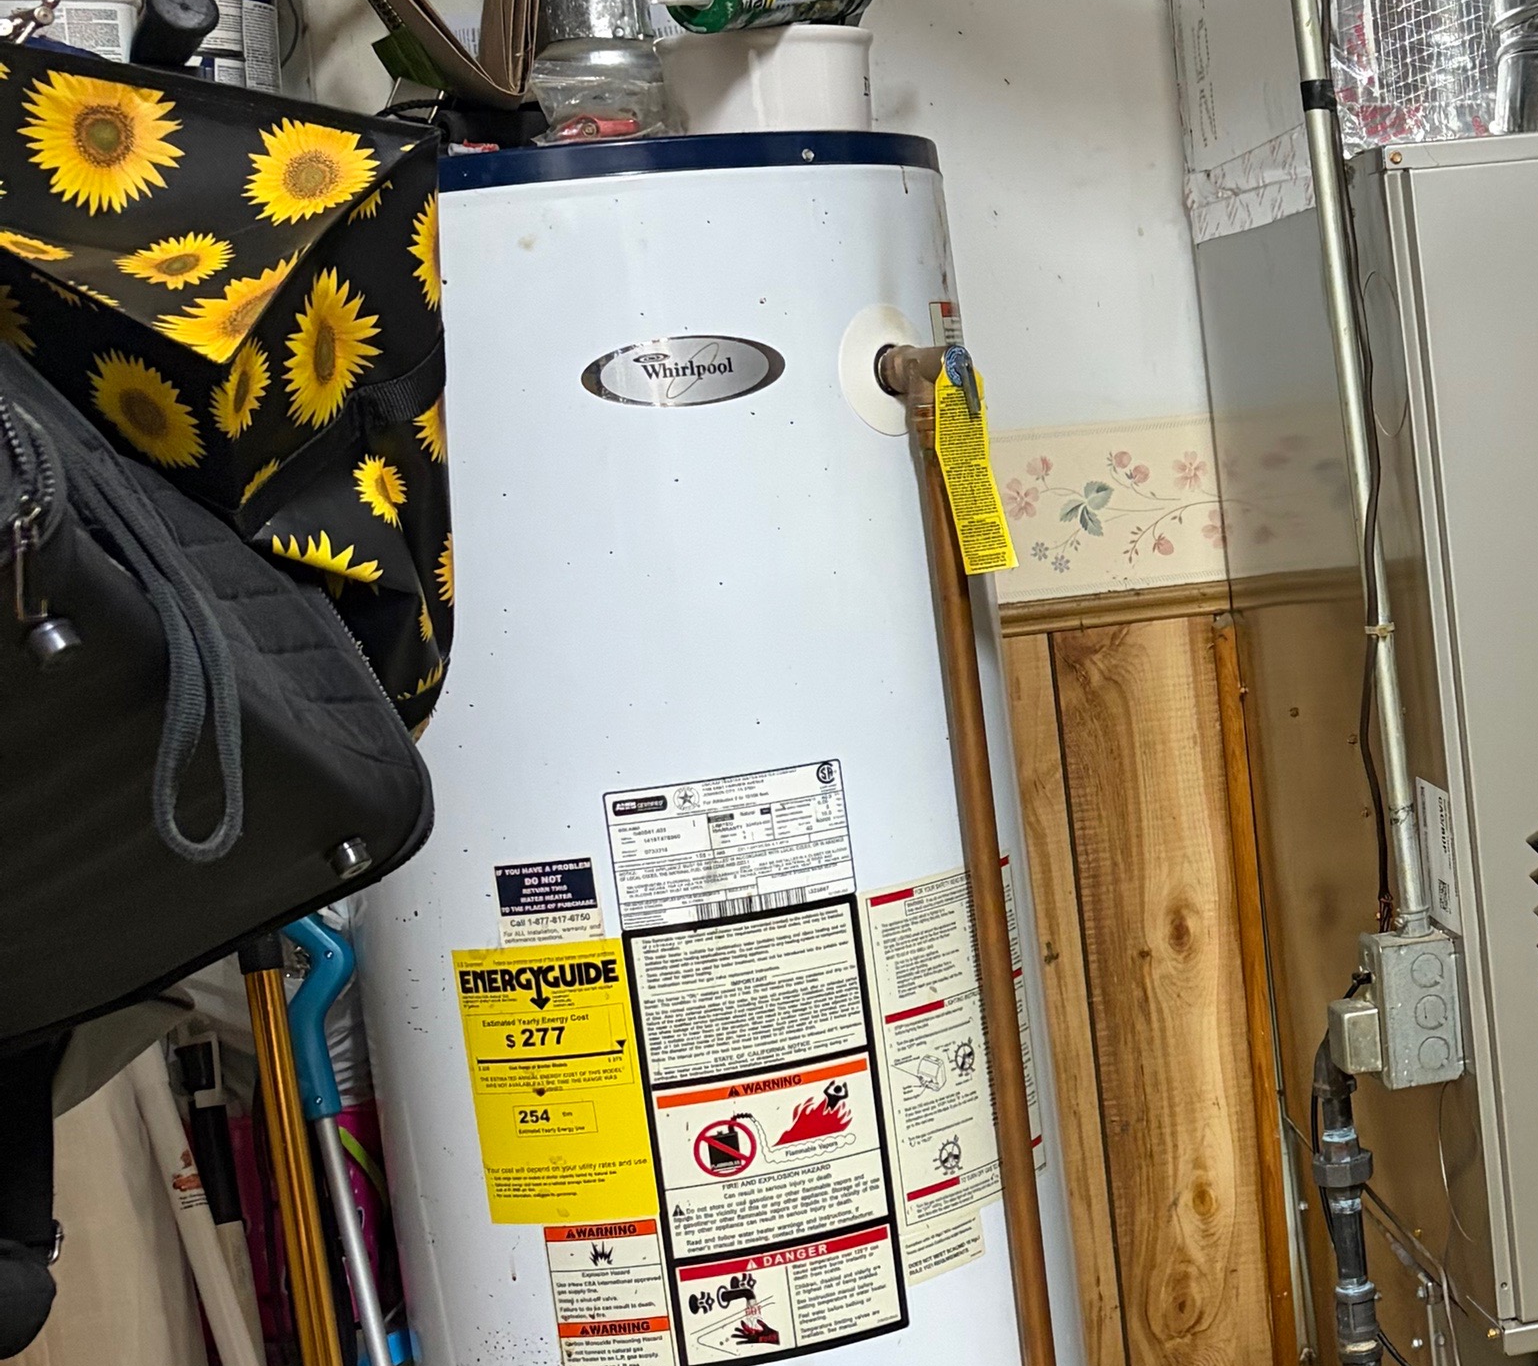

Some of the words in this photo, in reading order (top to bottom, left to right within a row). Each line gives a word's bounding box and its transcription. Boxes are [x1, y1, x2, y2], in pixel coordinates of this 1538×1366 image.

[641, 357, 734, 380] Whirlpool
[521, 866, 542, 874] HAVE
[551, 861, 590, 871] PROBLEM
[523, 876, 539, 885] DO
[540, 874, 563, 884] NOT
[519, 895, 543, 903] WATER
[544, 892, 572, 900] HEATER
[521, 886, 549, 894] RETURN
[524, 903, 545, 911] PLACE
[509, 918, 525, 927] Call
[458, 958, 620, 997] ENERGYGUIDE
[730, 975, 767, 986] IMPORTANT
[481, 1018, 515, 1028] Estimated
[517, 1016, 539, 1026] Yearly
[541, 1015, 568, 1025] Energy
[570, 1013, 588, 1021] Cost
[504, 1032, 516, 1048] $
[520, 1025, 567, 1047] 277
[742, 1073, 802, 1094] WARNING
[517, 1108, 550, 1124] 254
[785, 1145, 816, 1157] Flammable
[818, 1140, 838, 1150] Vapors
[500, 1166, 514, 1174] cost
[526, 1165, 550, 1174] depend
[561, 1164, 577, 1172] your
[578, 1162, 596, 1171] utility
[617, 1158, 631, 1166] and
[721, 1182, 738, 1190] FIRE
[740, 1179, 756, 1187] AND
[757, 1170, 799, 1183] EXPLOSION
[801, 1163, 831, 1174] HAZARD
[737, 1188, 754, 1196] result
[764, 1182, 786, 1191] serious
[788, 1178, 805, 1187] injury
[815, 1172, 832, 1181] death
[575, 1223, 637, 1238] WARNING
[762, 1243, 828, 1267] DANGER
[581, 1270, 608, 1278] Explosion
[610, 1268, 630, 1276] Hazard
[588, 1319, 650, 1336] WARNING
[585, 1338, 611, 1347] Monoxide
[612, 1336, 640, 1346] Poisoning
